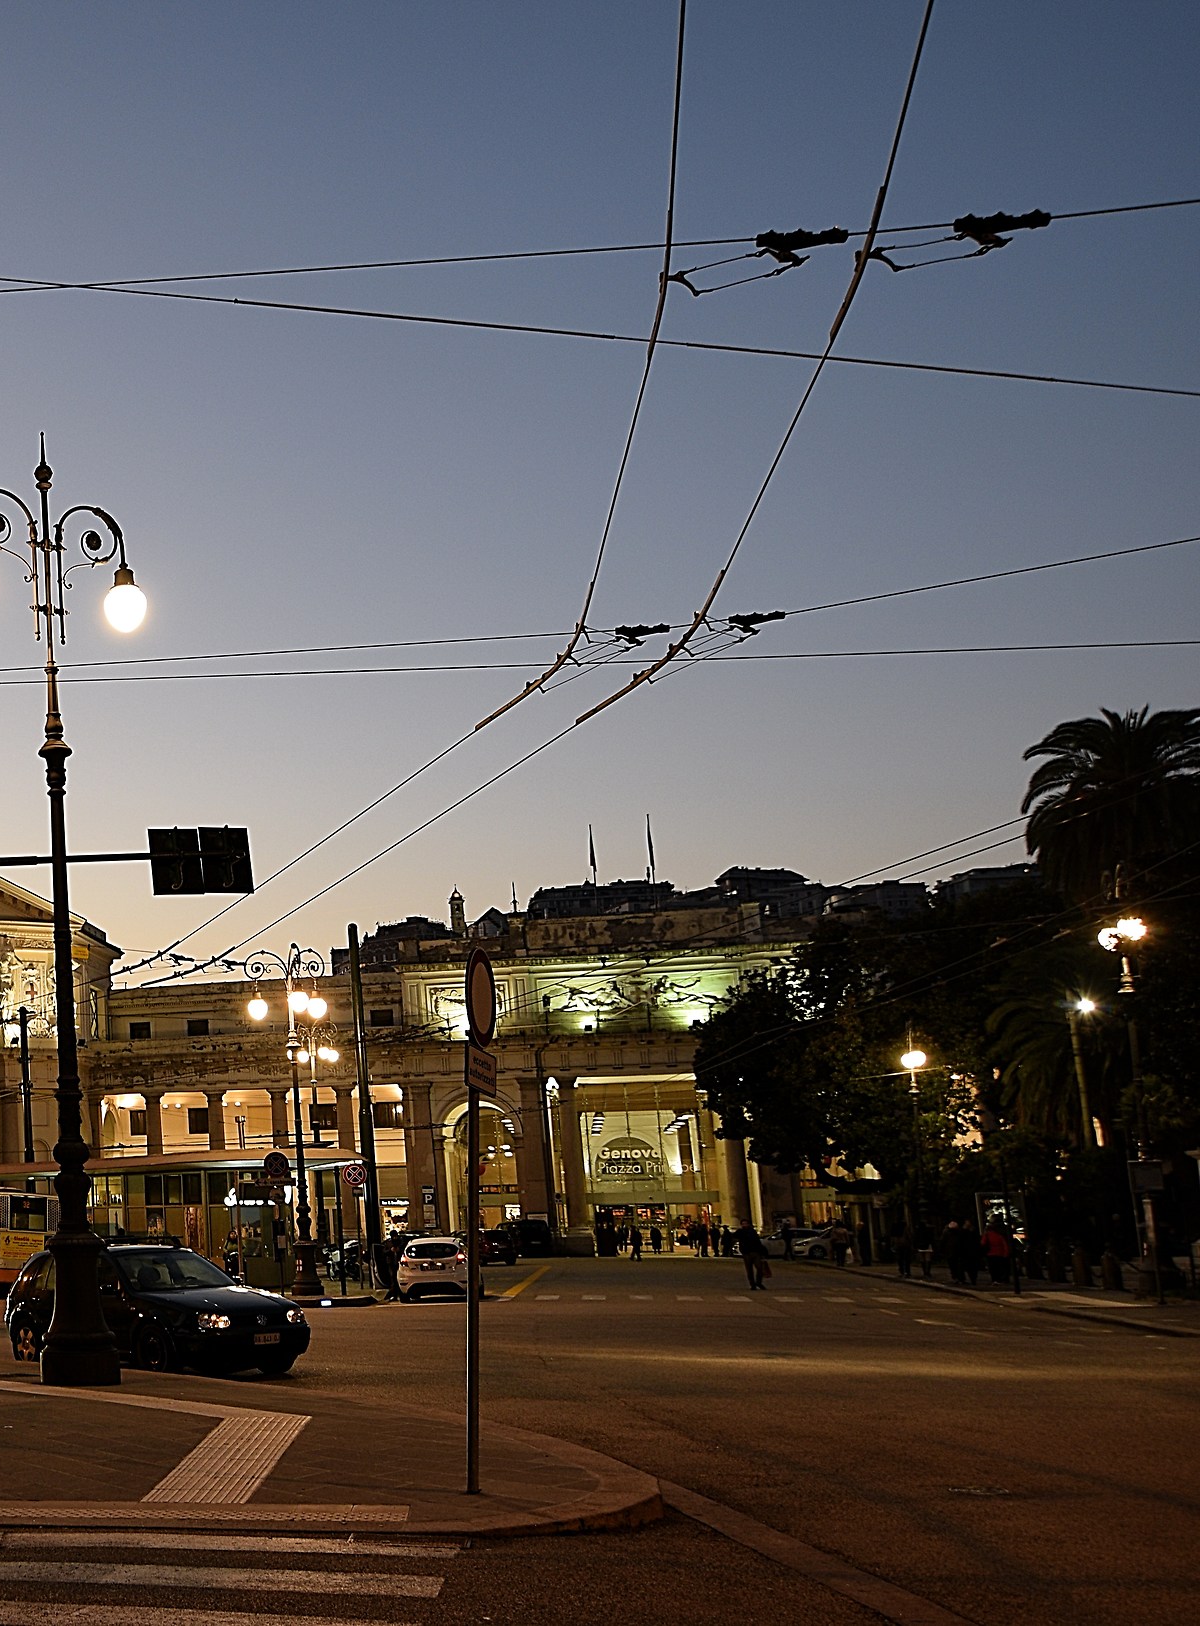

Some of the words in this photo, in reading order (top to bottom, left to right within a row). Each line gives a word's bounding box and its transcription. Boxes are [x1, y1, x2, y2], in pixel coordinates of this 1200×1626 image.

[598, 1147, 661, 1159] Genova
[598, 1161, 642, 1174] Piazza
[424, 1194, 433, 1204] P
